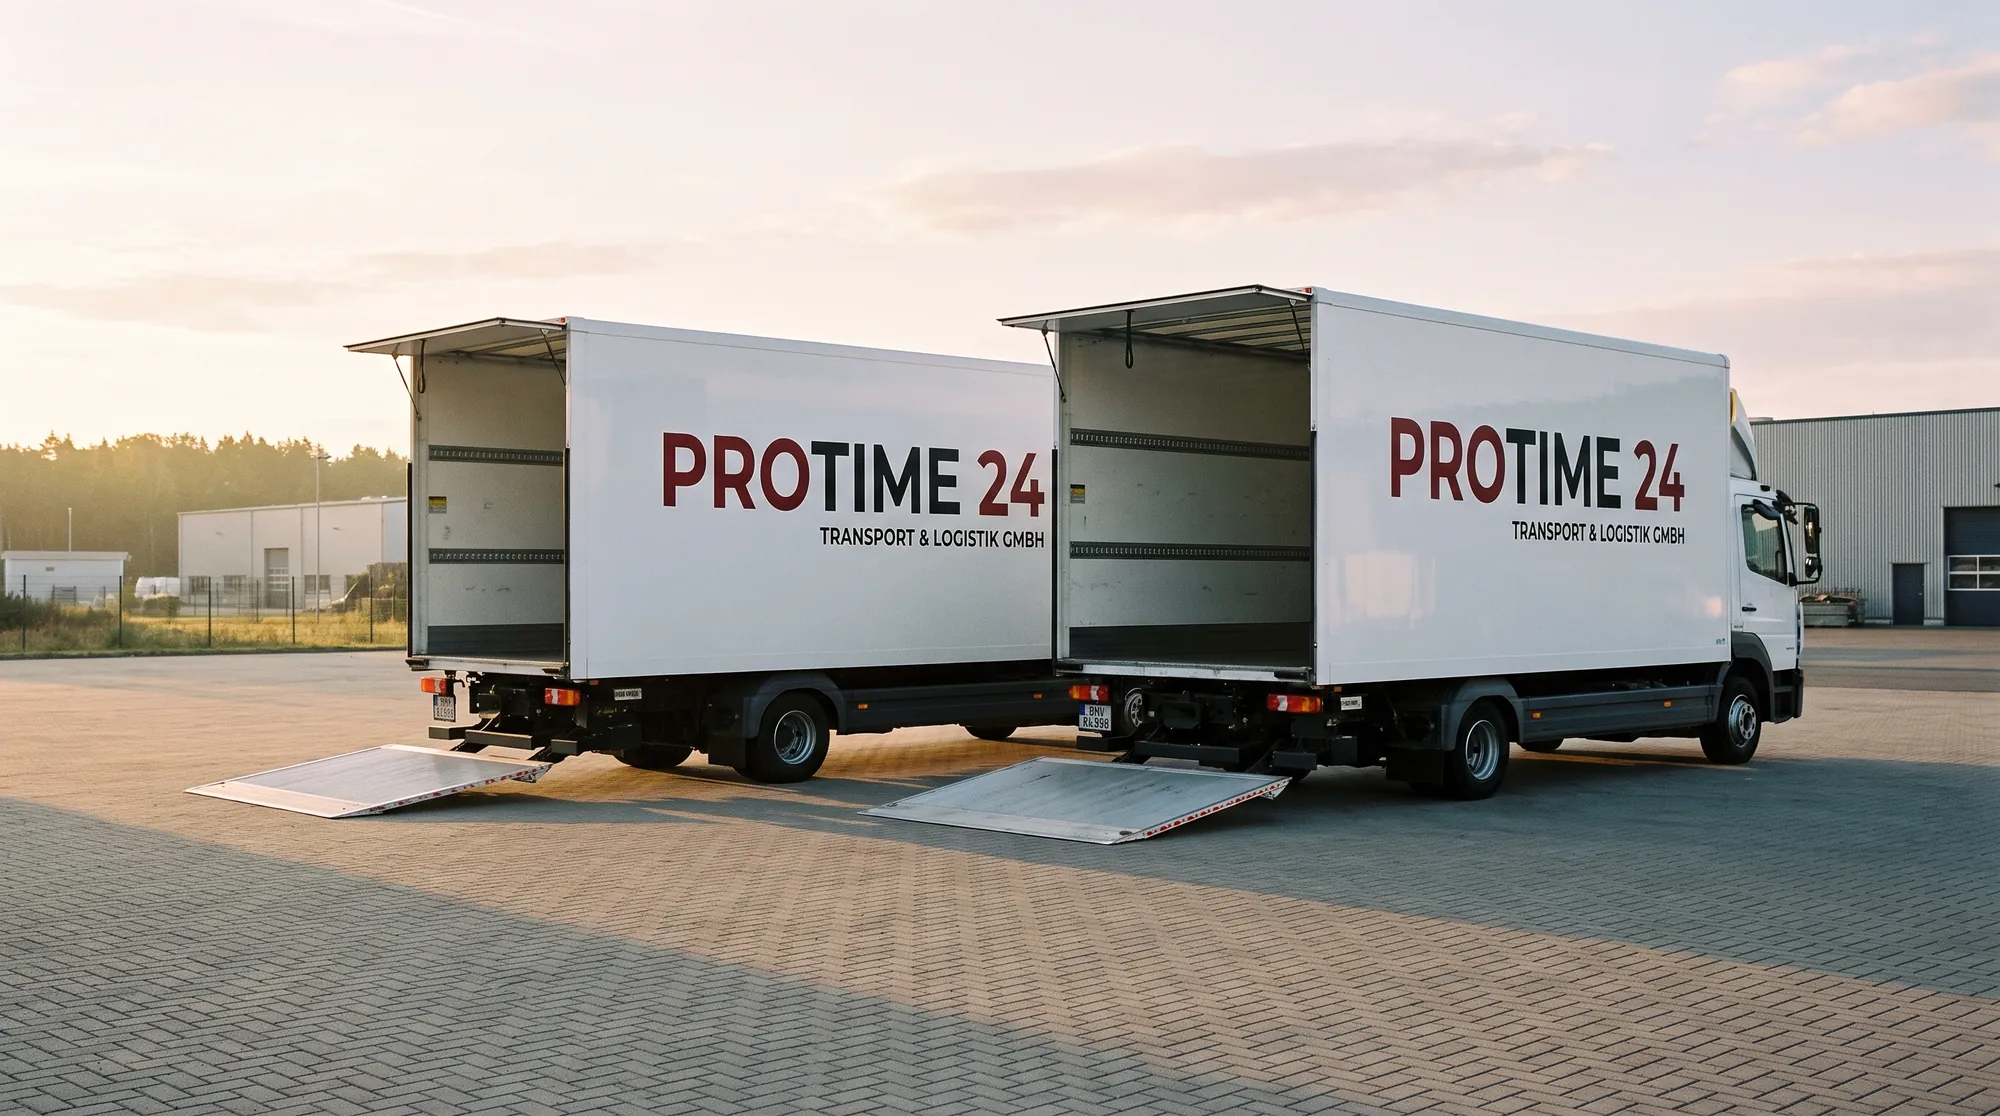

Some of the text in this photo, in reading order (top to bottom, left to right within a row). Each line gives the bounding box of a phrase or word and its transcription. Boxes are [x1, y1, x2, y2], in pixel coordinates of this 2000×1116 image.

[663, 432, 1045, 517] PROTIME 24
[1391, 417, 1685, 512] PROTIME 24
[820, 527, 1045, 548] TRANSPORT & LOGISTIK GMBH
[1512, 521, 1685, 544] TRANSPORT & LOGISTIK GMBH
